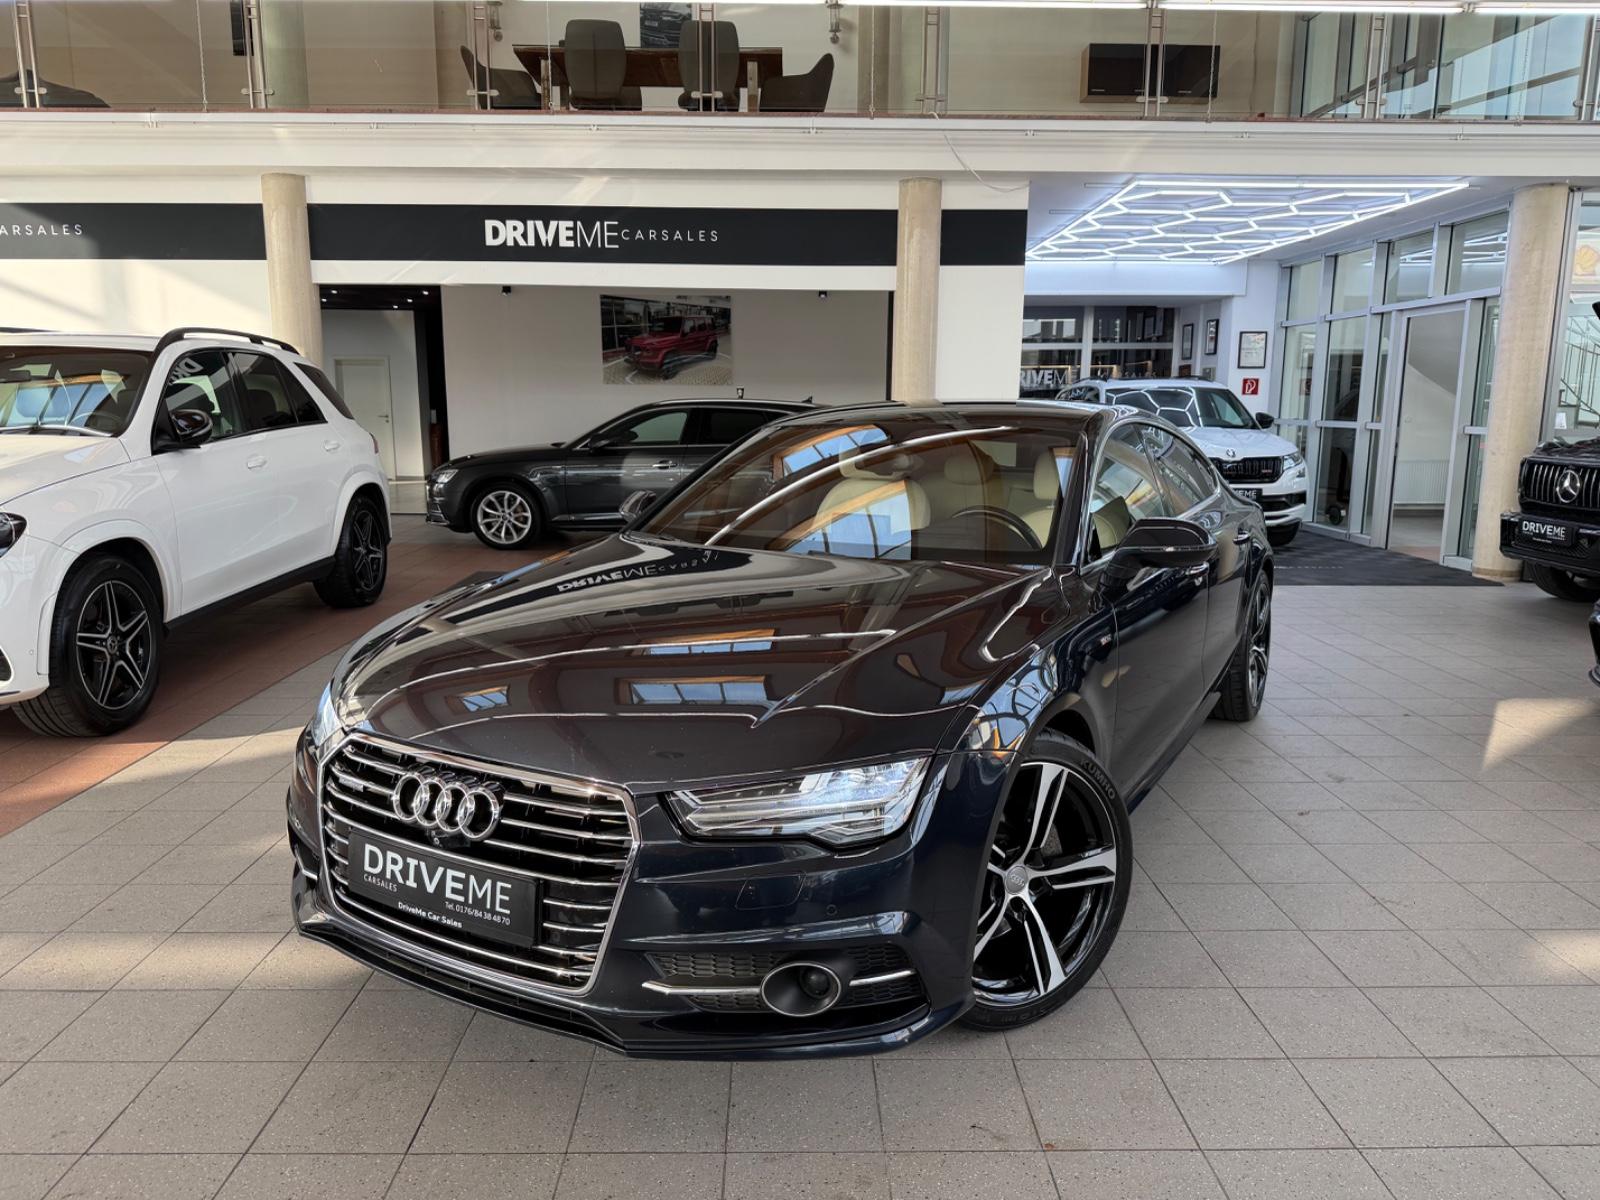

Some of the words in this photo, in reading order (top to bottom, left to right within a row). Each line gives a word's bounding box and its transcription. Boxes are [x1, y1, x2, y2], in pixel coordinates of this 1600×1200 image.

[484, 219, 619, 248] DRIVEME
[621, 229, 718, 242] CARSALES
[1522, 521, 1566, 537] DRIVEME
[1080, 758, 1116, 800] KUMHO
[363, 843, 512, 914] DRIVEME
[363, 874, 398, 893] CARSALES
[397, 901, 426, 918] DriveMe
[427, 910, 440, 921] Car
[441, 915, 463, 928] Sales
